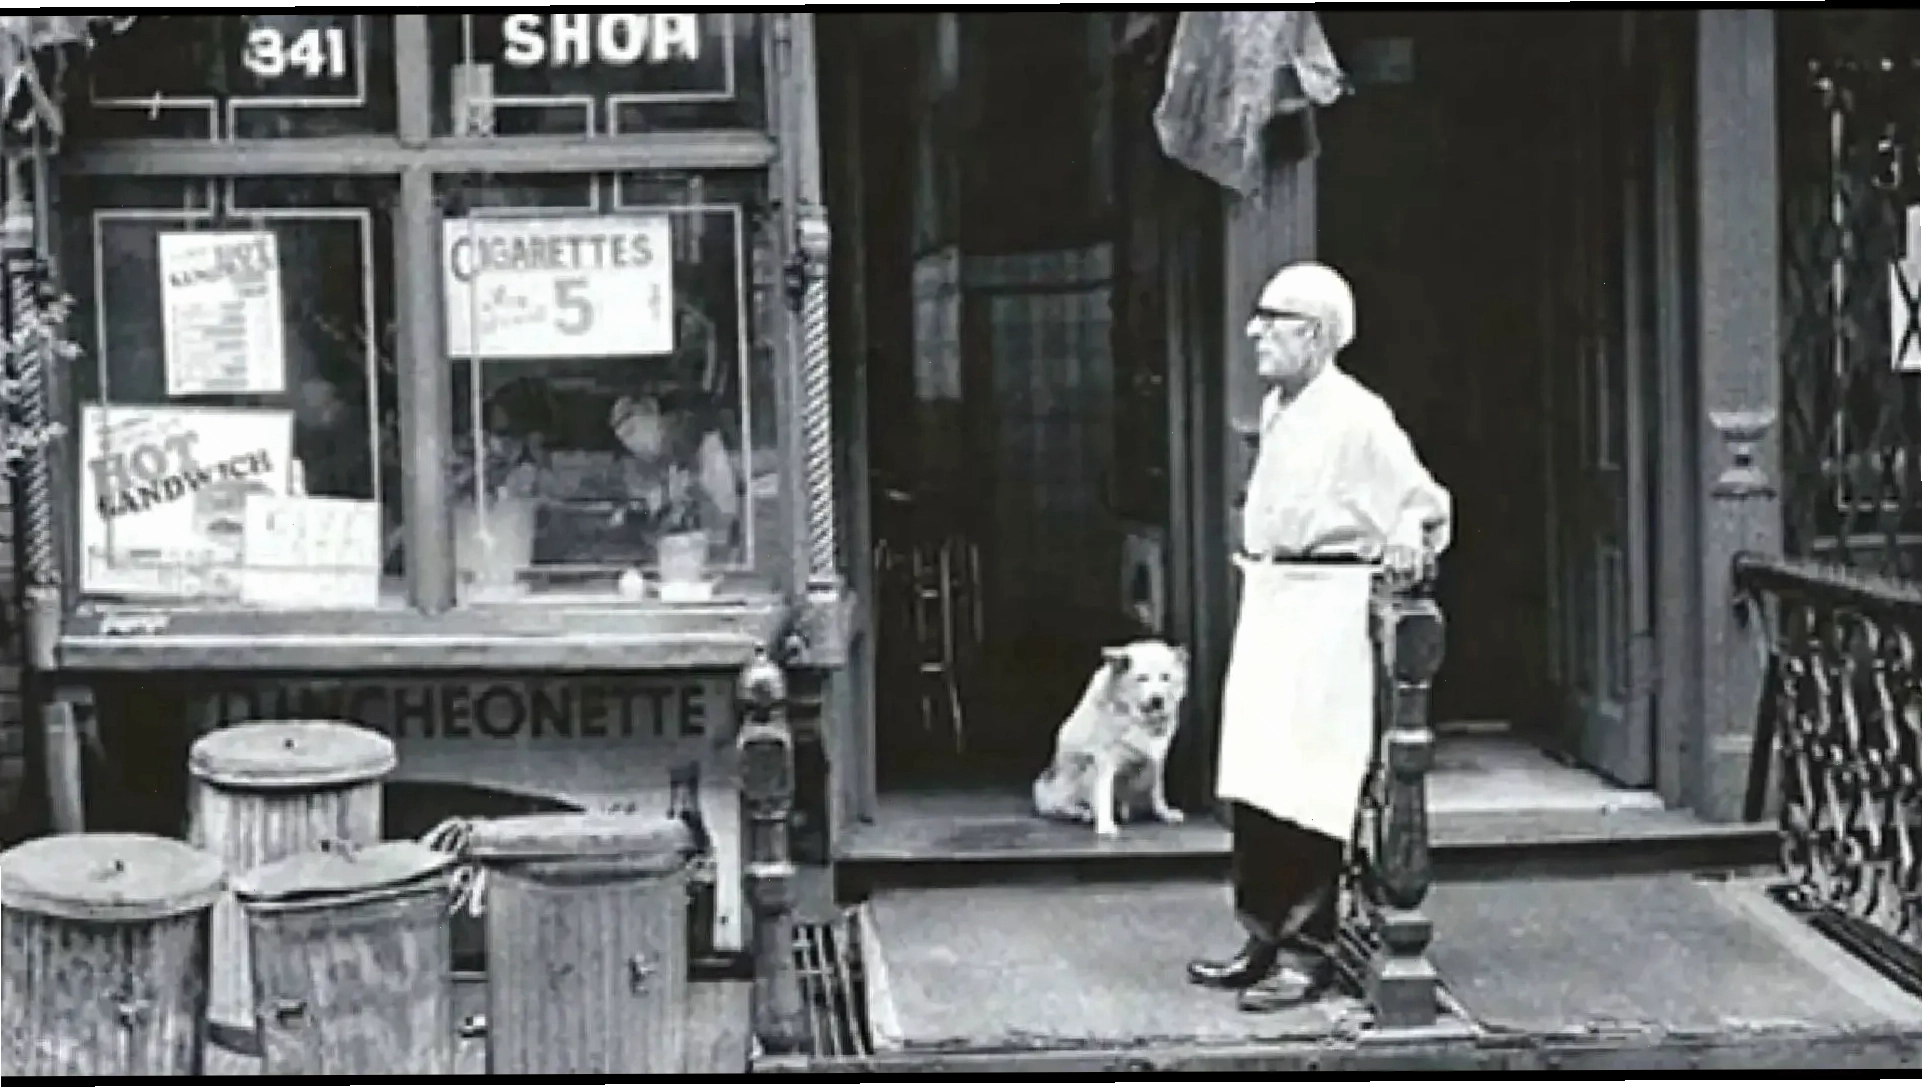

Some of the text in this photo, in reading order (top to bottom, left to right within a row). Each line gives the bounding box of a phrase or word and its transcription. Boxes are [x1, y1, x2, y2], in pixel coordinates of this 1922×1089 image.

[243, 28, 347, 77] 341
[451, 233, 654, 282] CIGARETTES
[553, 275, 595, 336] 5
[88, 430, 200, 501] HOT
[96, 448, 274, 518] SANDWICH
